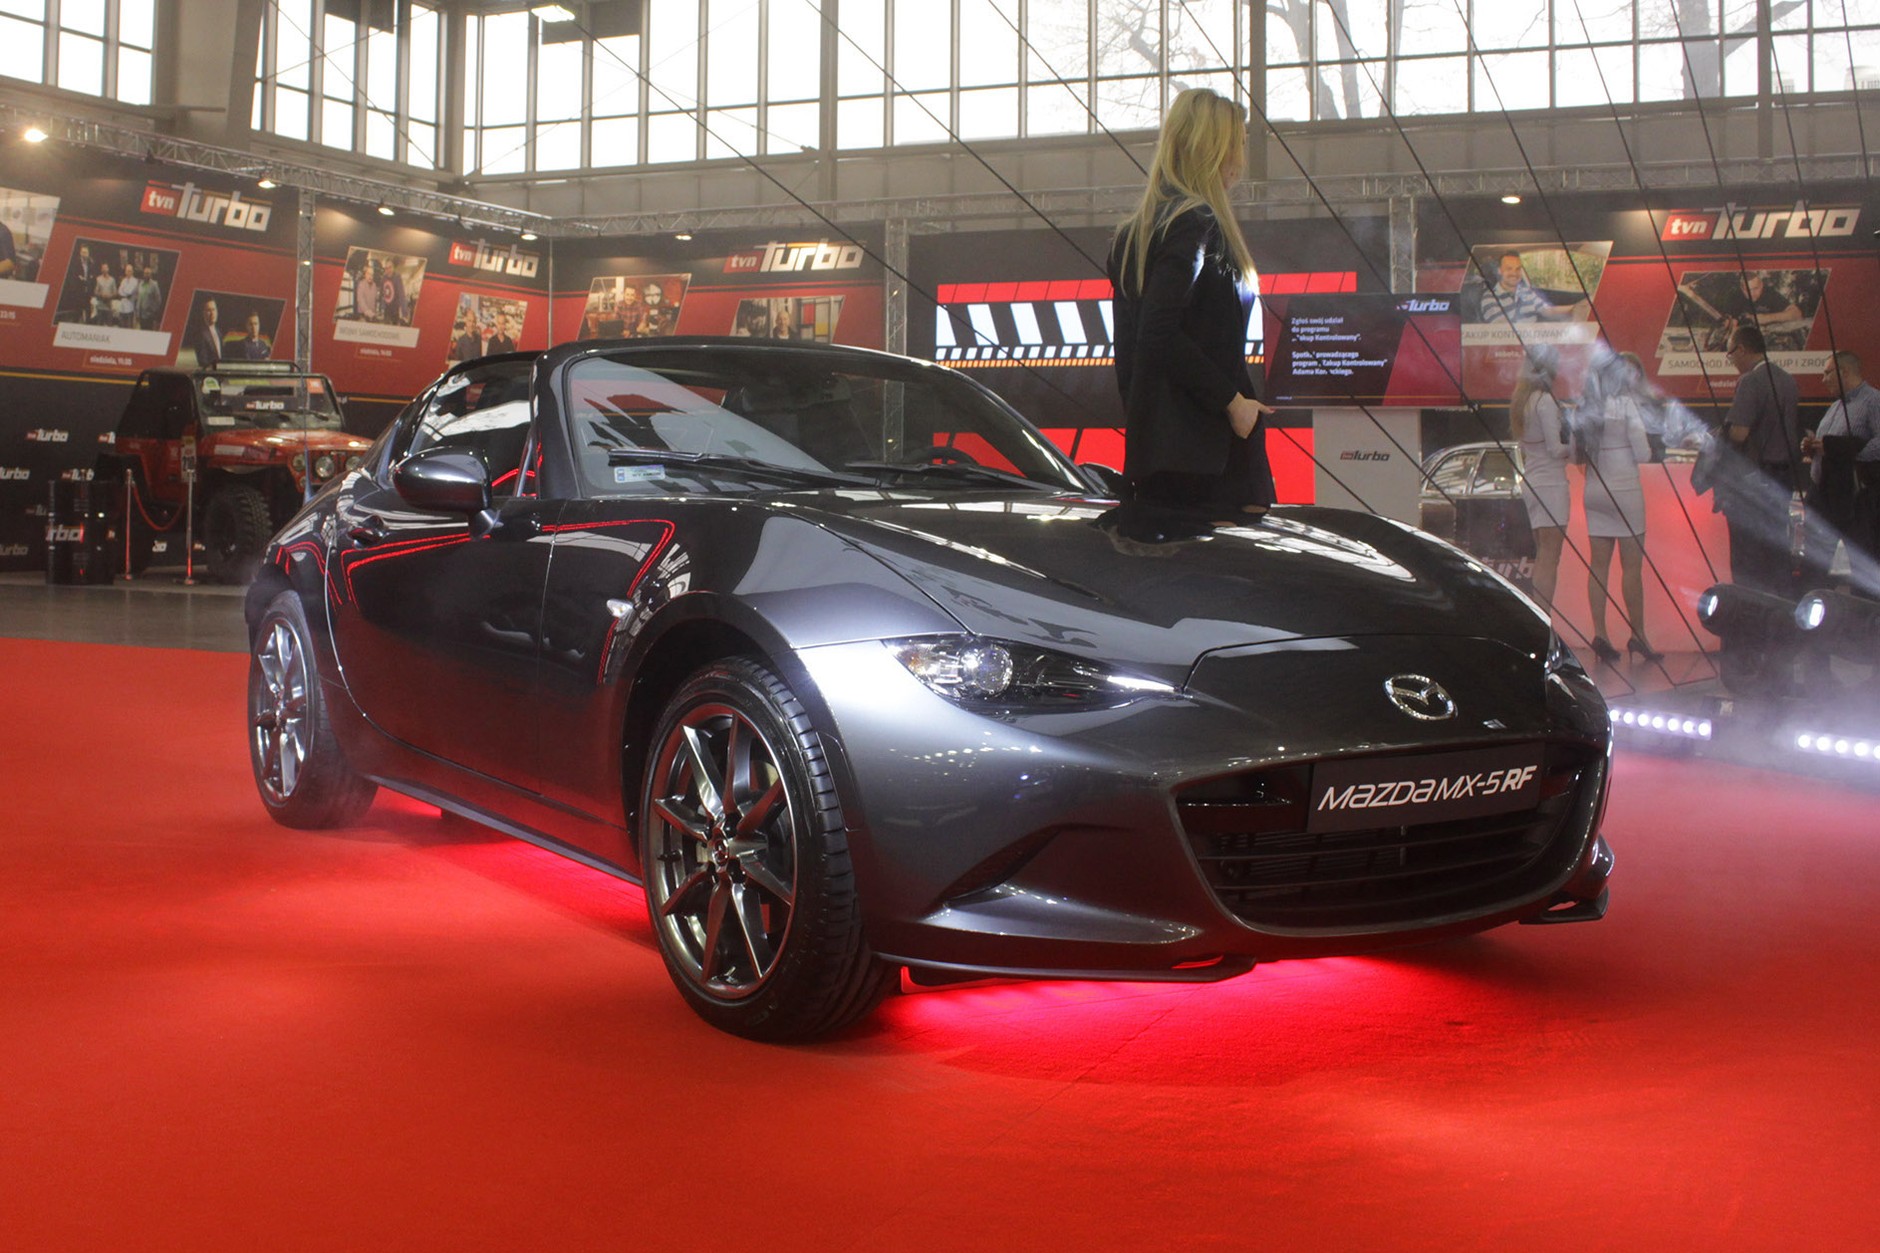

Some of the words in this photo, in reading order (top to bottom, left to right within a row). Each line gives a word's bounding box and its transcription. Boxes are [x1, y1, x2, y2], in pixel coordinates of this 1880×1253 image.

[148, 190, 175, 210] tvn
[1670, 217, 1708, 235] tvn
[454, 246, 473, 262] tvn
[731, 254, 757, 268] tvn
